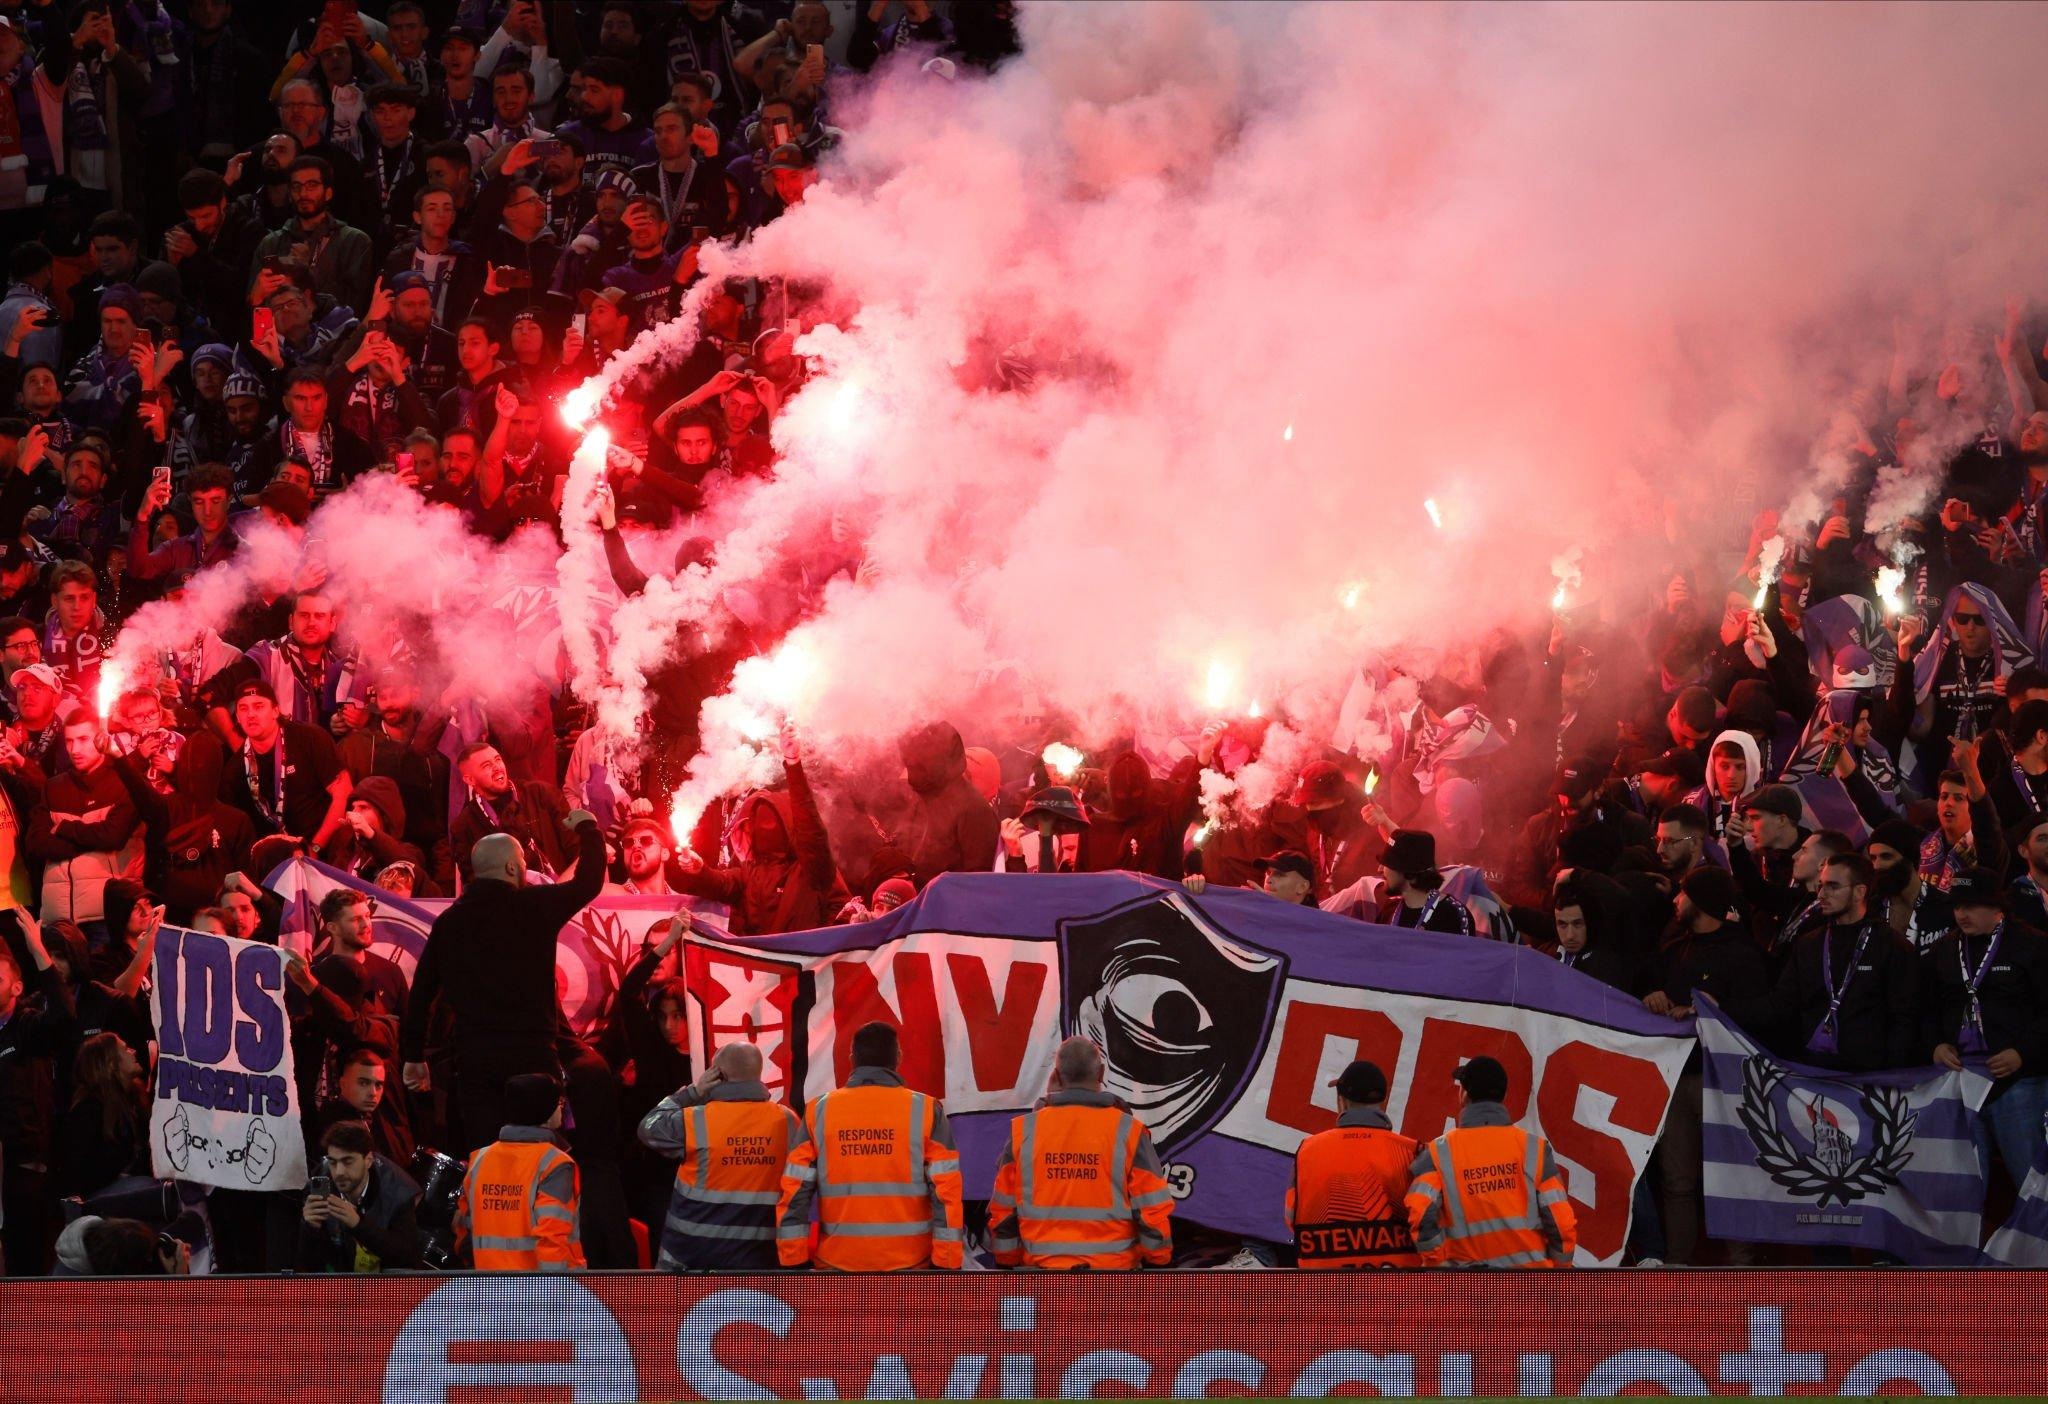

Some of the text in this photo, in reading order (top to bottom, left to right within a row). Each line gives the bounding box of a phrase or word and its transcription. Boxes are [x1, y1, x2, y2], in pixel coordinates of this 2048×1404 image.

[154, 928, 284, 1073] IDS
[727, 1136, 772, 1146] DEPUTY
[838, 1128, 894, 1142] RESPONSE
[734, 1147, 765, 1155] HEAD
[841, 1143, 893, 1156] STEWARD
[722, 1156, 776, 1166] STEWARD
[1045, 1152, 1100, 1166] RESPONSE
[1047, 1168, 1097, 1180] STEWARD
[1464, 1162, 1518, 1181] RESPONSE
[1467, 1178, 1516, 1196] STEWARD
[1300, 1226, 1412, 1253] STEWAR
